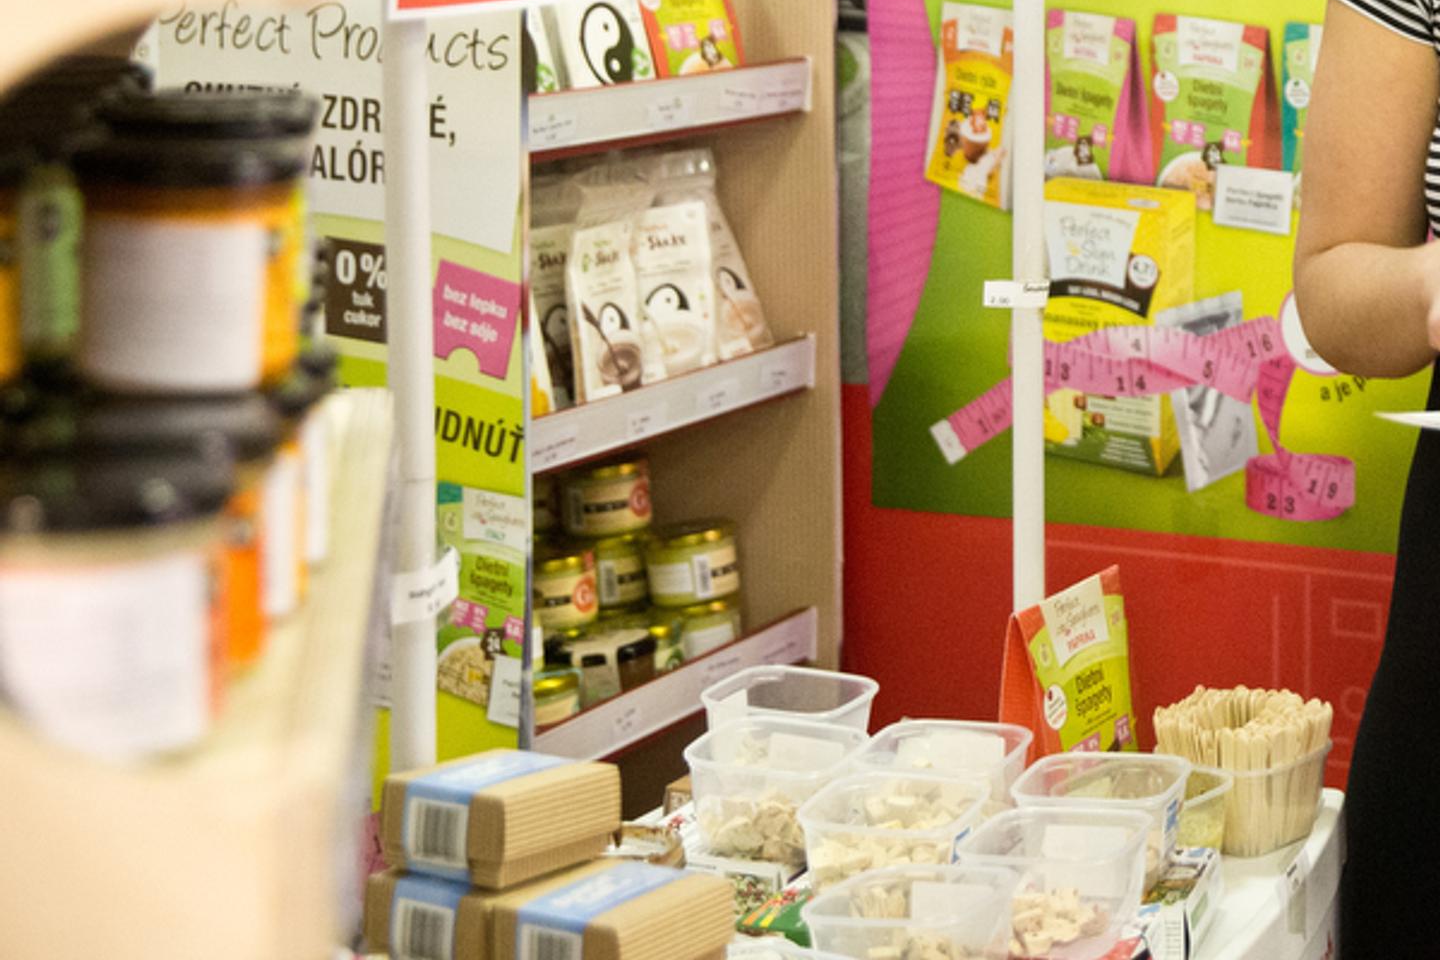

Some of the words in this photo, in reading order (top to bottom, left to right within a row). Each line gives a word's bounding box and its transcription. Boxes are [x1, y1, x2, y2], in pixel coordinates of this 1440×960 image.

[443, 285, 467, 306] bez
[443, 312, 467, 333] bez
[1320, 386, 1331, 402] a
